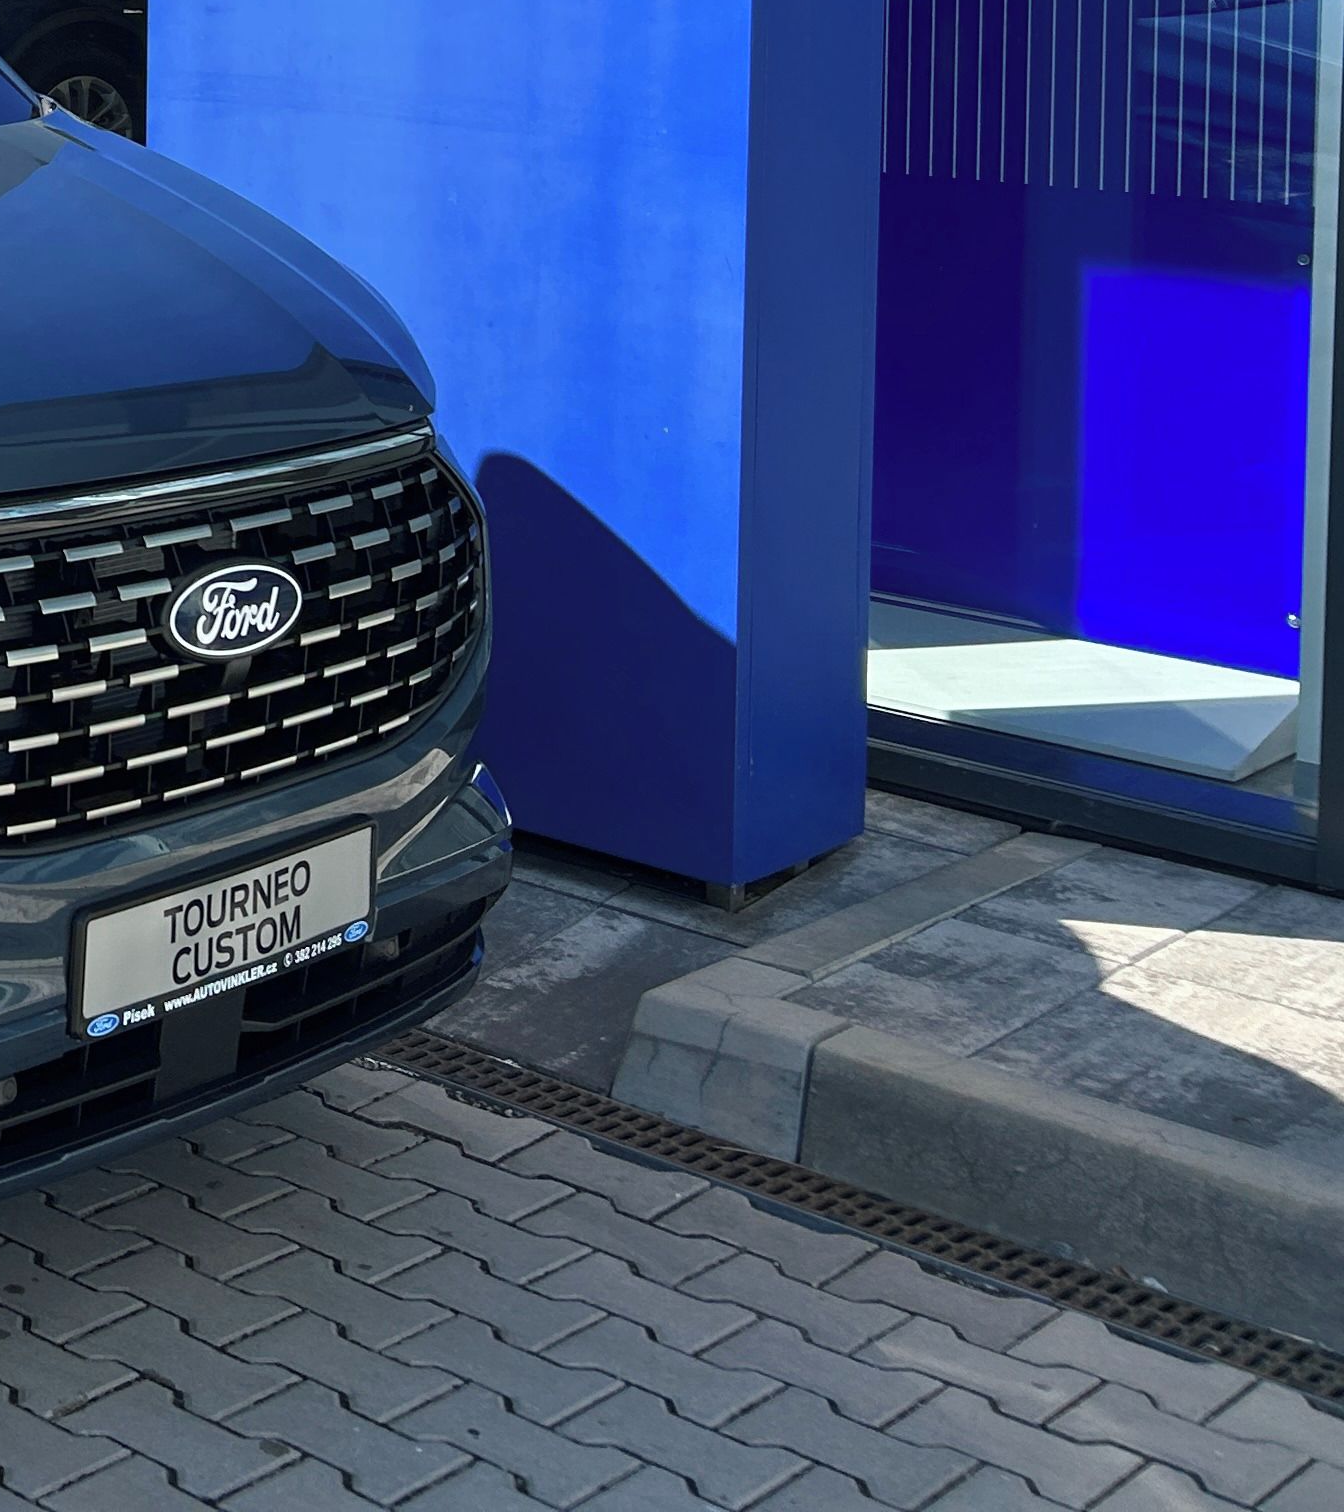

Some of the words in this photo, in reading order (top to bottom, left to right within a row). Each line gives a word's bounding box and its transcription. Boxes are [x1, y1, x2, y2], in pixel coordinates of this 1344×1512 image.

[196, 577, 280, 645] Ford
[163, 860, 311, 944] TOURNEO
[163, 962, 278, 1012] www.AUTOVINKLER.cz
[310, 942, 326, 958] 214
[172, 904, 302, 985] CUSTOM
